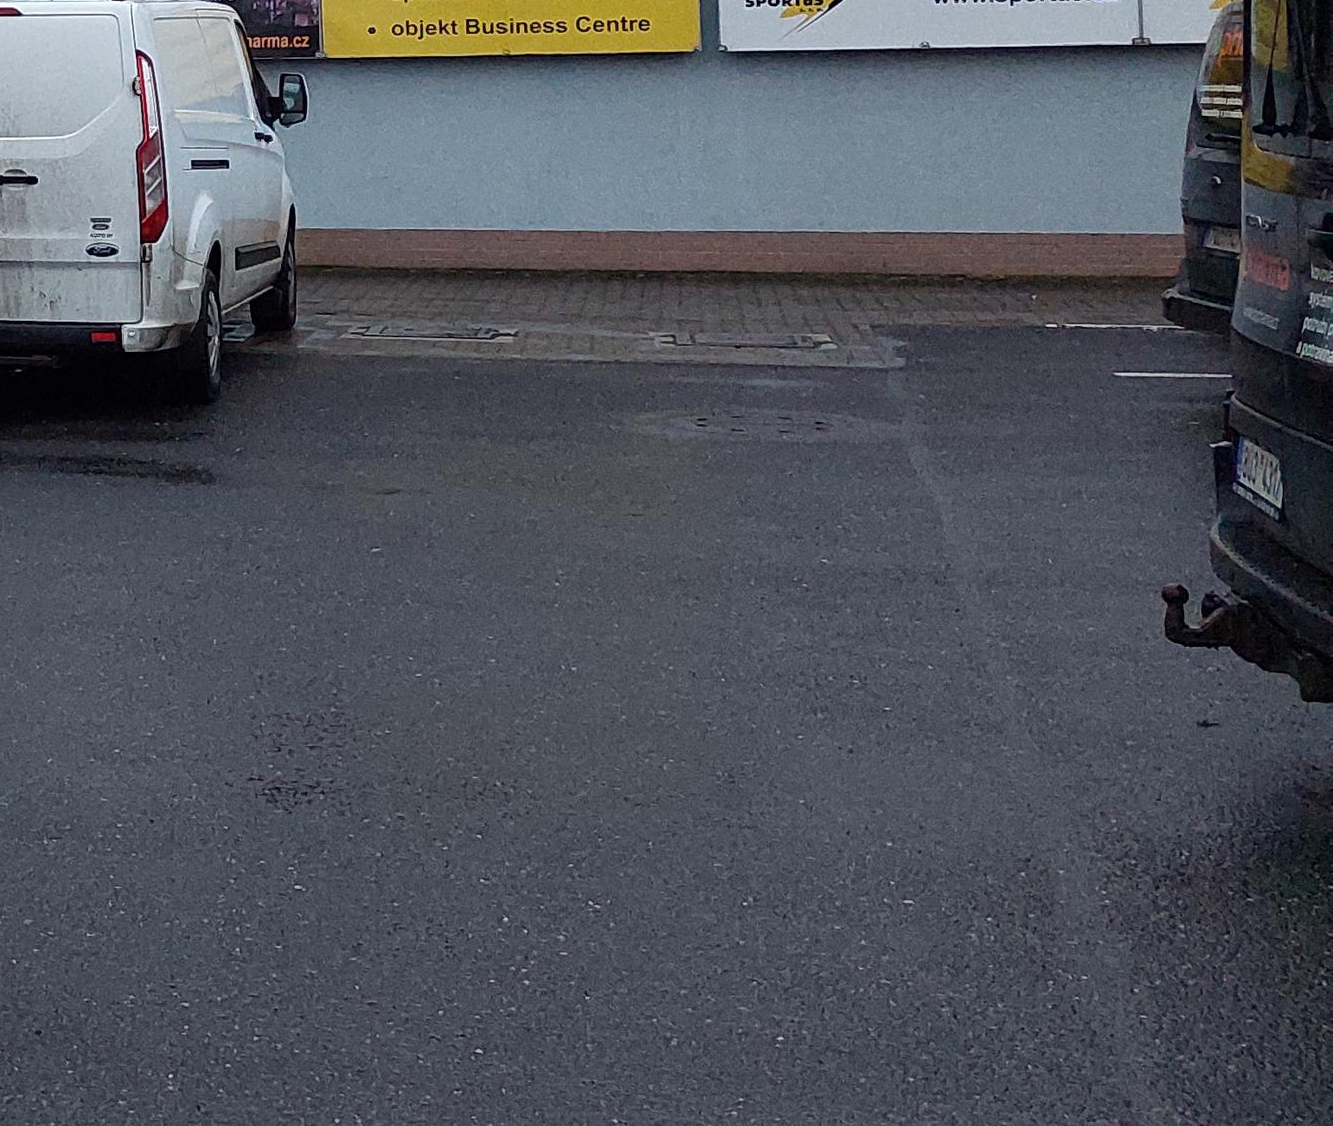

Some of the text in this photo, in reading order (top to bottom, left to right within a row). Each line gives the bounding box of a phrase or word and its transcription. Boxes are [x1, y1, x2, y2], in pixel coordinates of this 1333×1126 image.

[391, 14, 651, 40] objekt Business Centre
